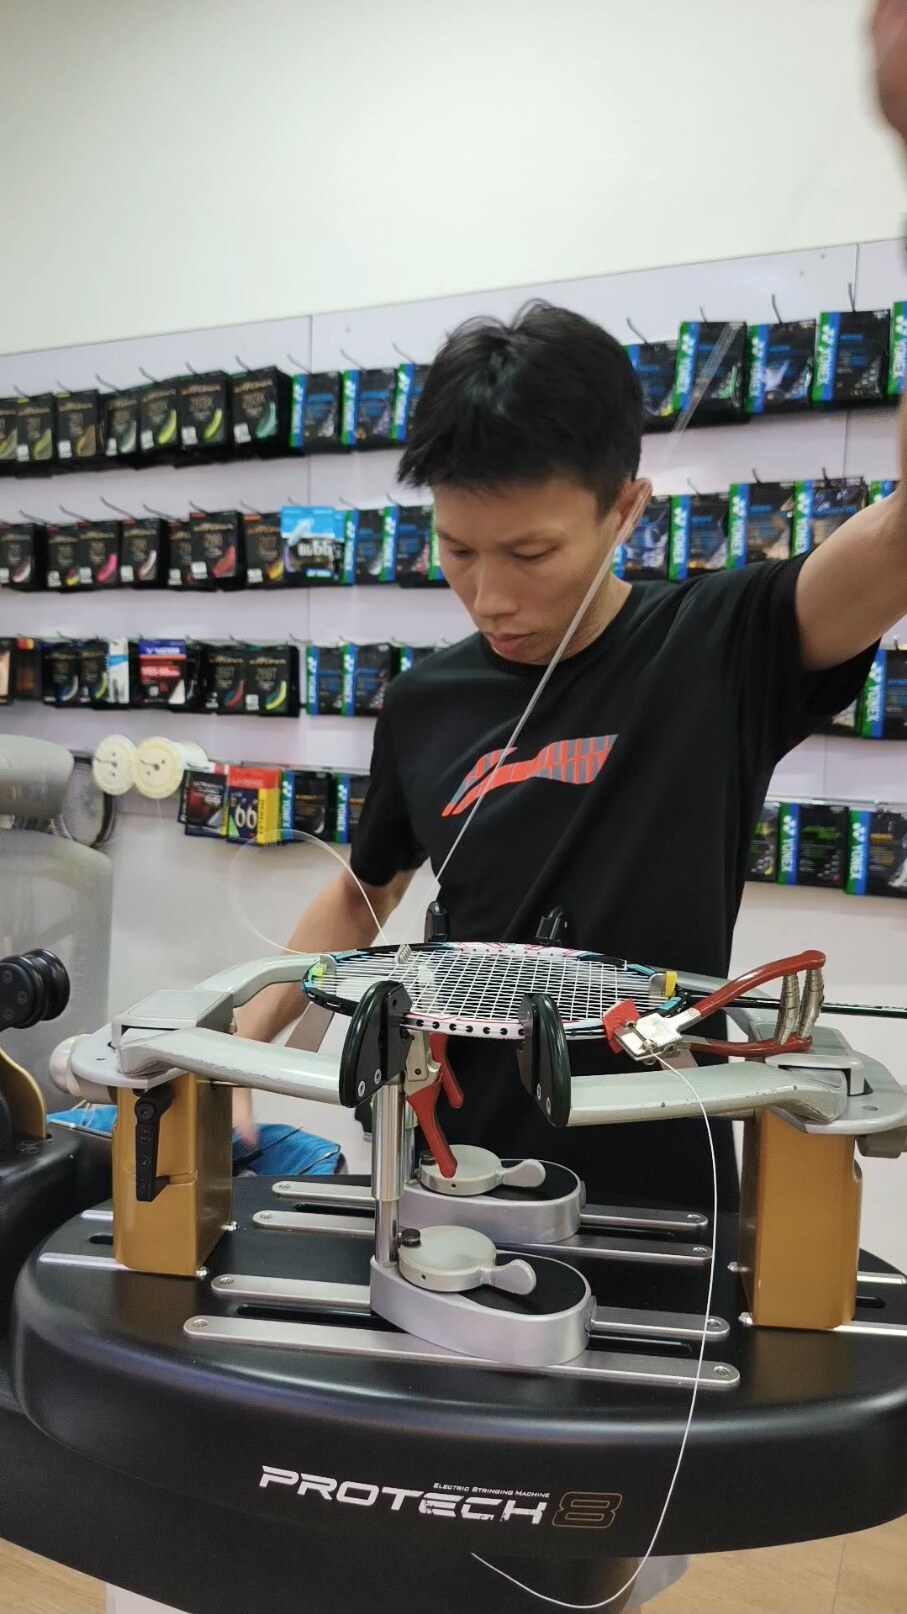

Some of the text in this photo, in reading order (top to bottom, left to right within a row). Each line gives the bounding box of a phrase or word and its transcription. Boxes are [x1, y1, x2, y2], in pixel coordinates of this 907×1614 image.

[781, 838, 796, 872] YONEX
[849, 844, 864, 880] YONEX
[259, 1465, 623, 1529] PROTECH 8
[433, 1482, 550, 1498] ELECTRIC STRINGING MACHINE
